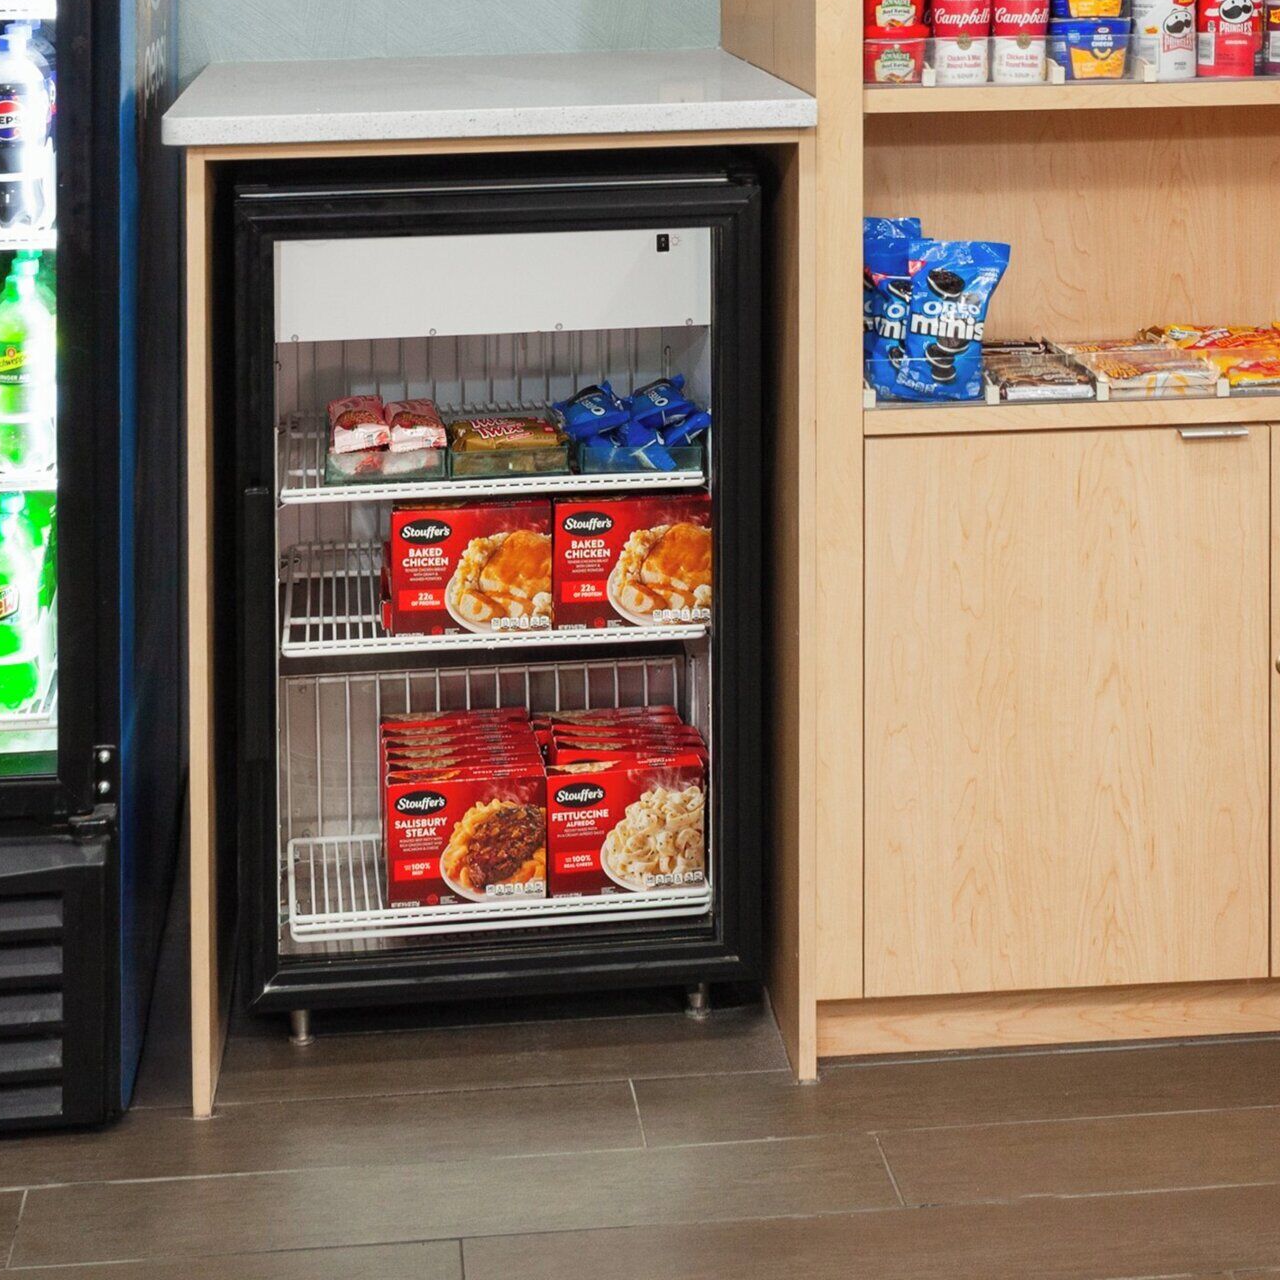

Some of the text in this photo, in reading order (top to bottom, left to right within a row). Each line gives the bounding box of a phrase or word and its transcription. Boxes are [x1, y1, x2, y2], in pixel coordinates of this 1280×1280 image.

[934, 8, 990, 27] Campbell
[995, 8, 1049, 27] Campbell
[1220, 21, 1252, 36] PRINGLES
[911, 313, 984, 340] minis
[564, 518, 612, 531] Stouffer's
[402, 526, 450, 539] Stouffer's
[571, 540, 605, 549] BAKED
[409, 548, 442, 557] BAKED
[565, 549, 611, 559] CHICKEN
[402, 558, 449, 567] CHICKEN
[556, 789, 604, 802] Stouffer's
[397, 797, 445, 810] Stouffer's
[552, 809, 609, 821] FETTUCCINE
[395, 817, 447, 829] SALISBURY
[406, 828, 436, 837] STEAK
